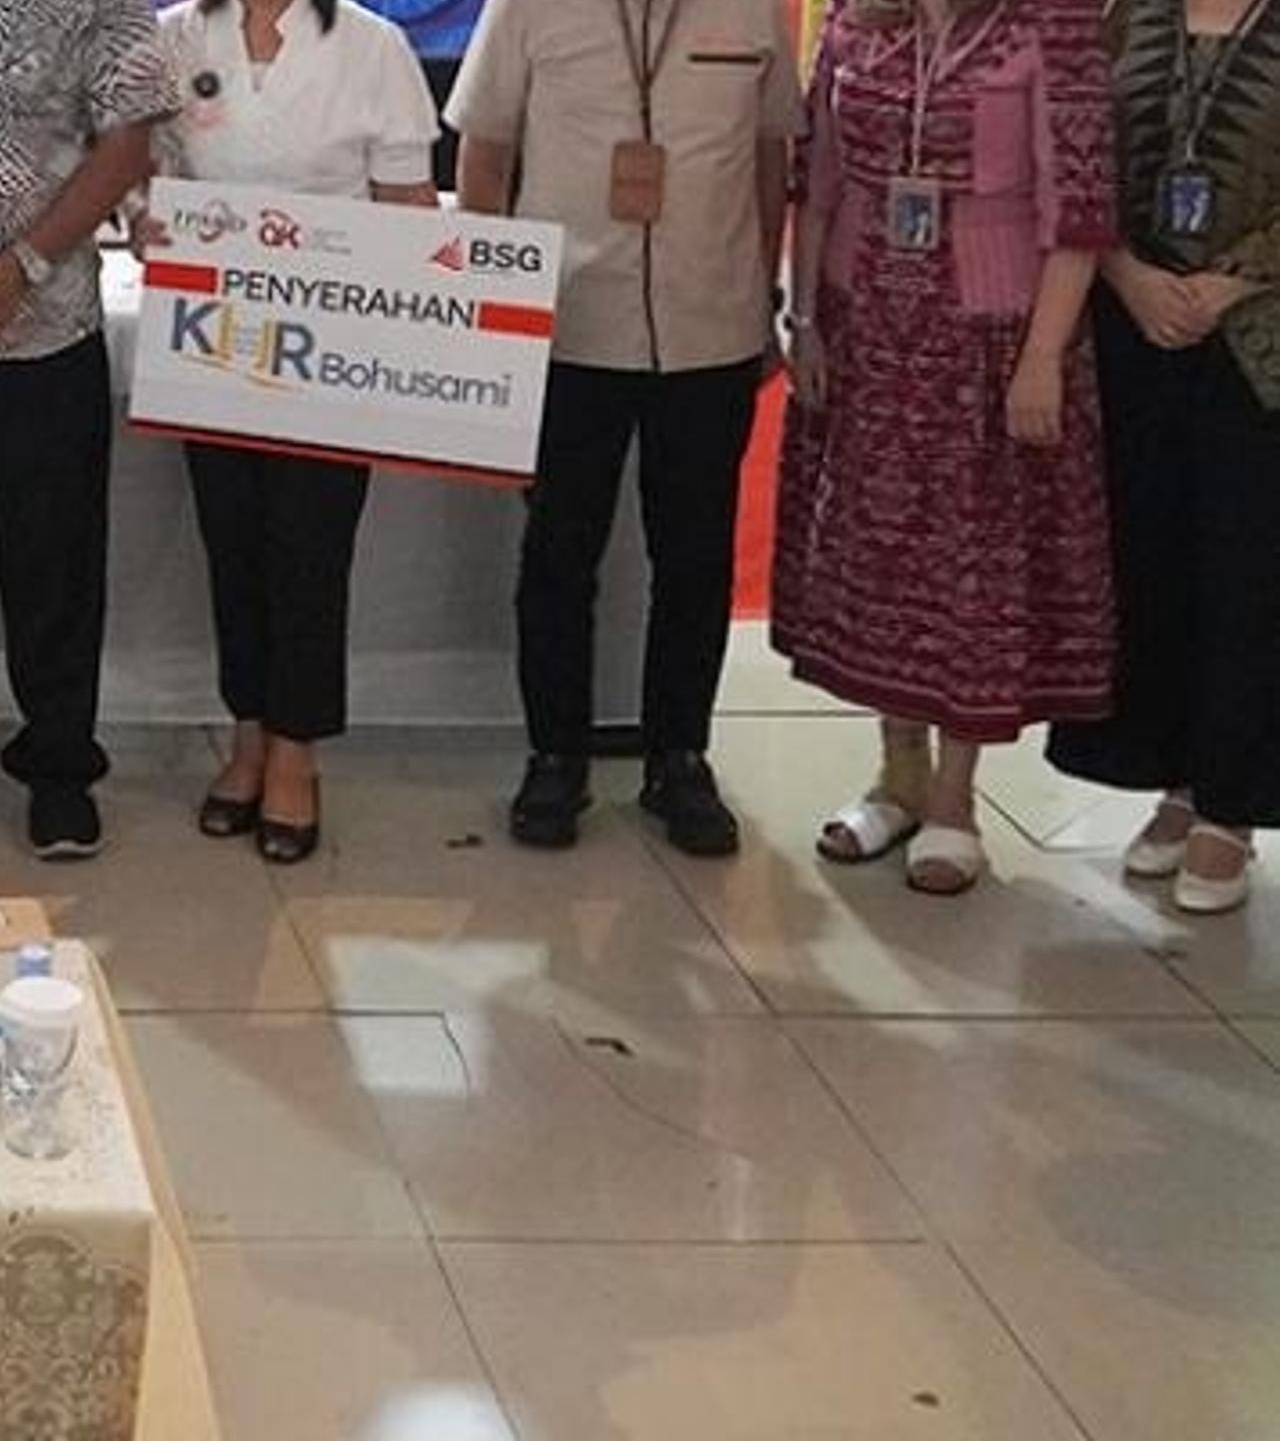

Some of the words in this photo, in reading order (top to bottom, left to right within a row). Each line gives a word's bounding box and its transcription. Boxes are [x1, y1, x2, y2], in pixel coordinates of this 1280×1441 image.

[468, 239, 544, 273] BSG
[220, 268, 478, 330] PENYERAHAN
[317, 351, 514, 409] Bohusami
